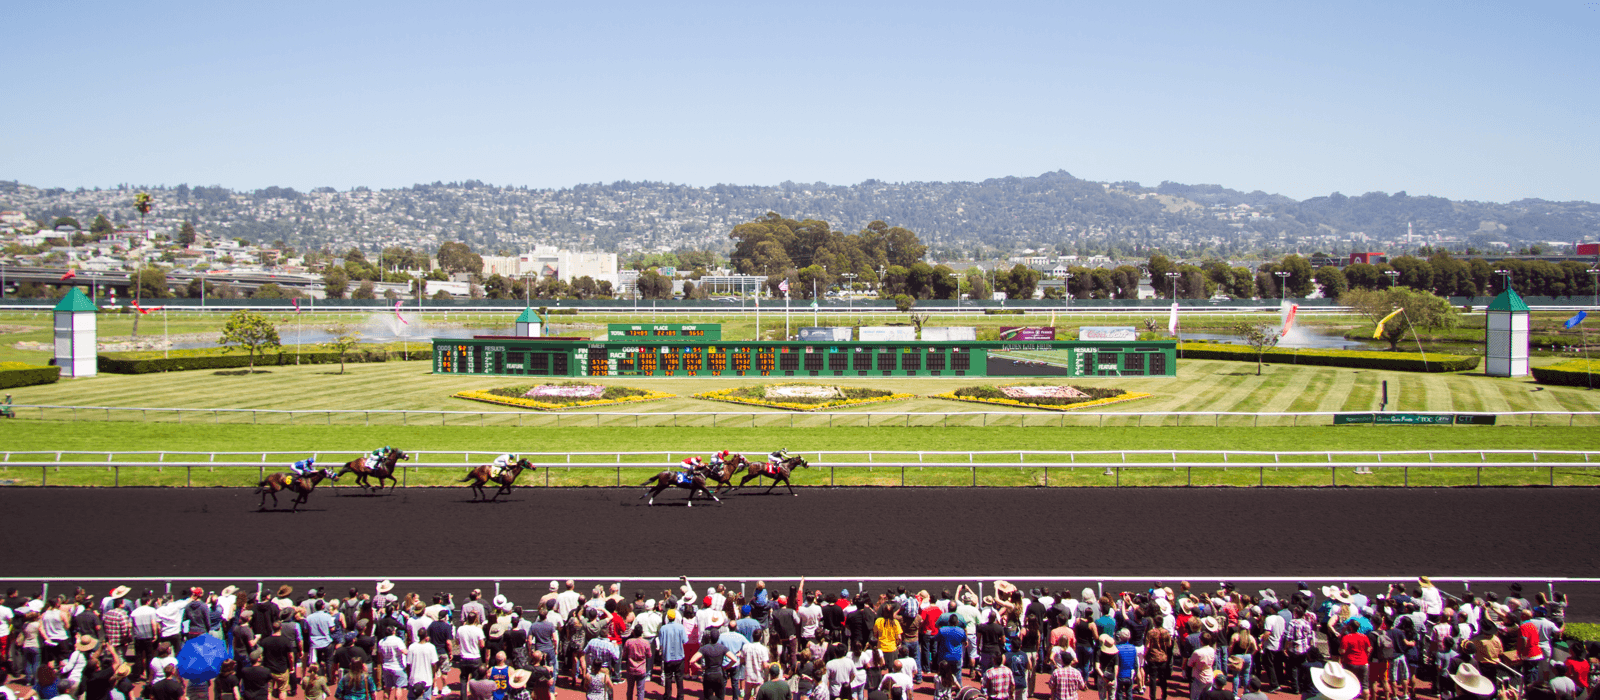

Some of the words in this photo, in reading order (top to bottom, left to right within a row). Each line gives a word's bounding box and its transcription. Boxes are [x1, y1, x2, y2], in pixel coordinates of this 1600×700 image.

[286, 476, 292, 484] 6
[677, 474, 683, 483] 3
[495, 680, 507, 689] 35
